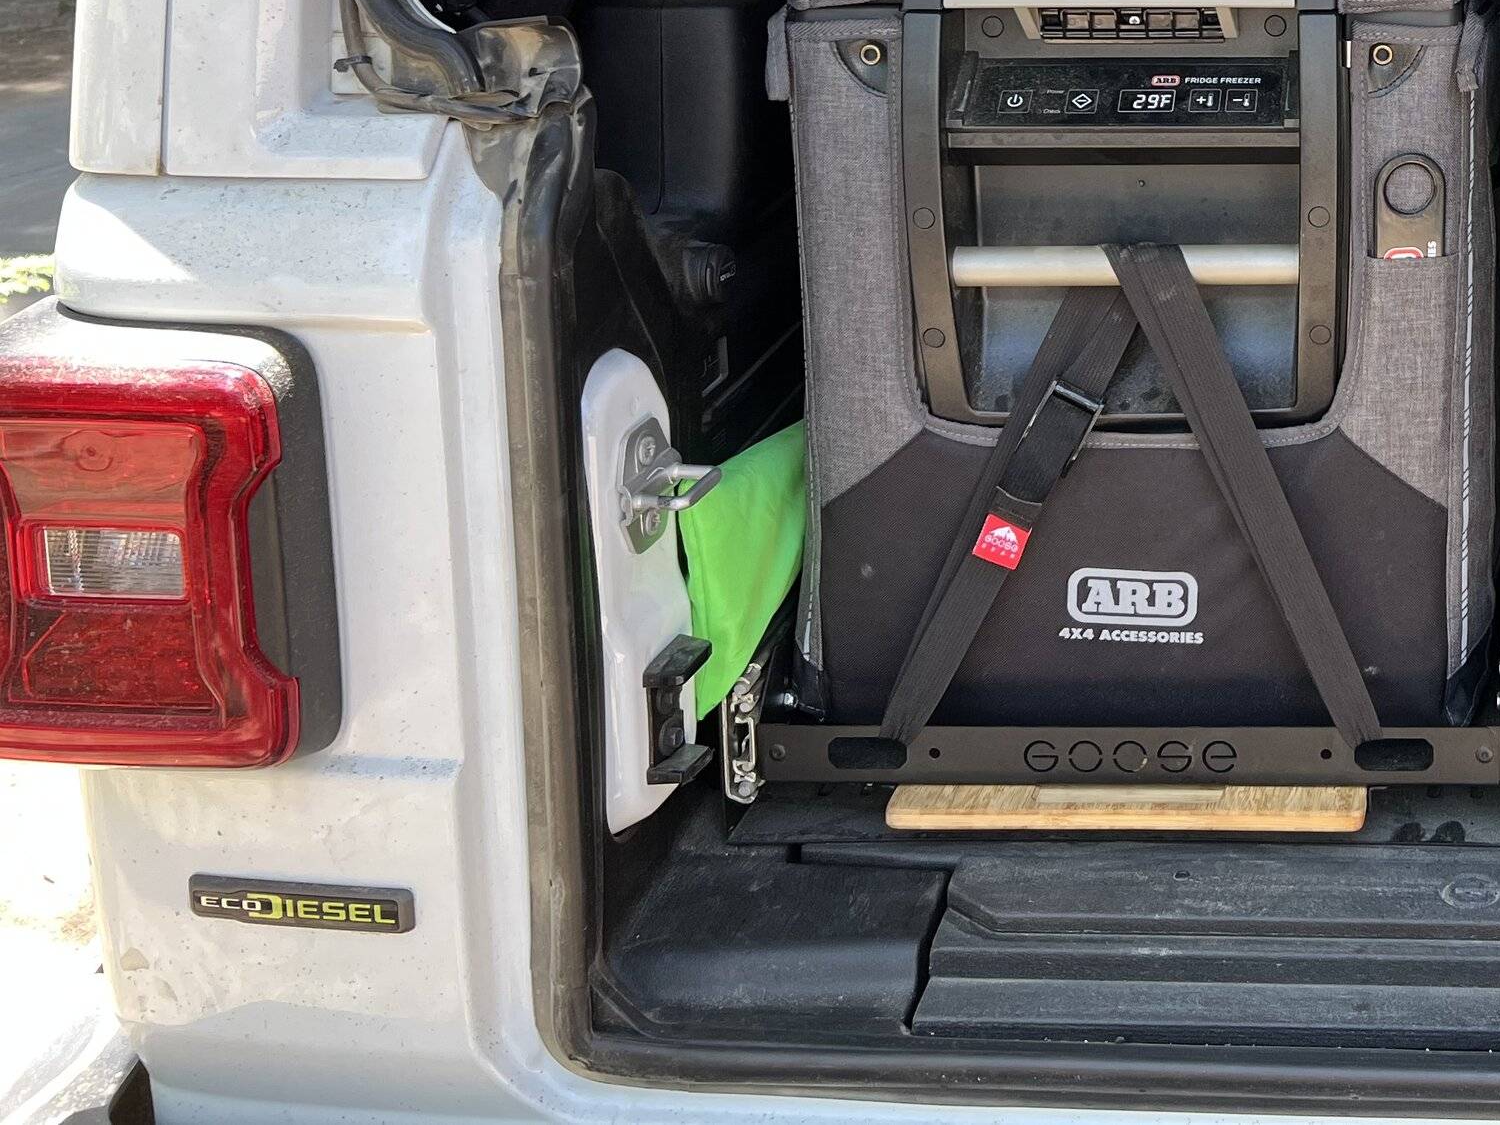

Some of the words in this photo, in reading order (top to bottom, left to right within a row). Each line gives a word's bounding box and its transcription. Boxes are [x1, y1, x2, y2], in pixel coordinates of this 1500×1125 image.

[1133, 94, 1172, 109] 29F
[1081, 578, 1186, 616] ARB
[1058, 627, 1095, 641] 4X4
[1099, 628, 1205, 645] ACCESSORIES
